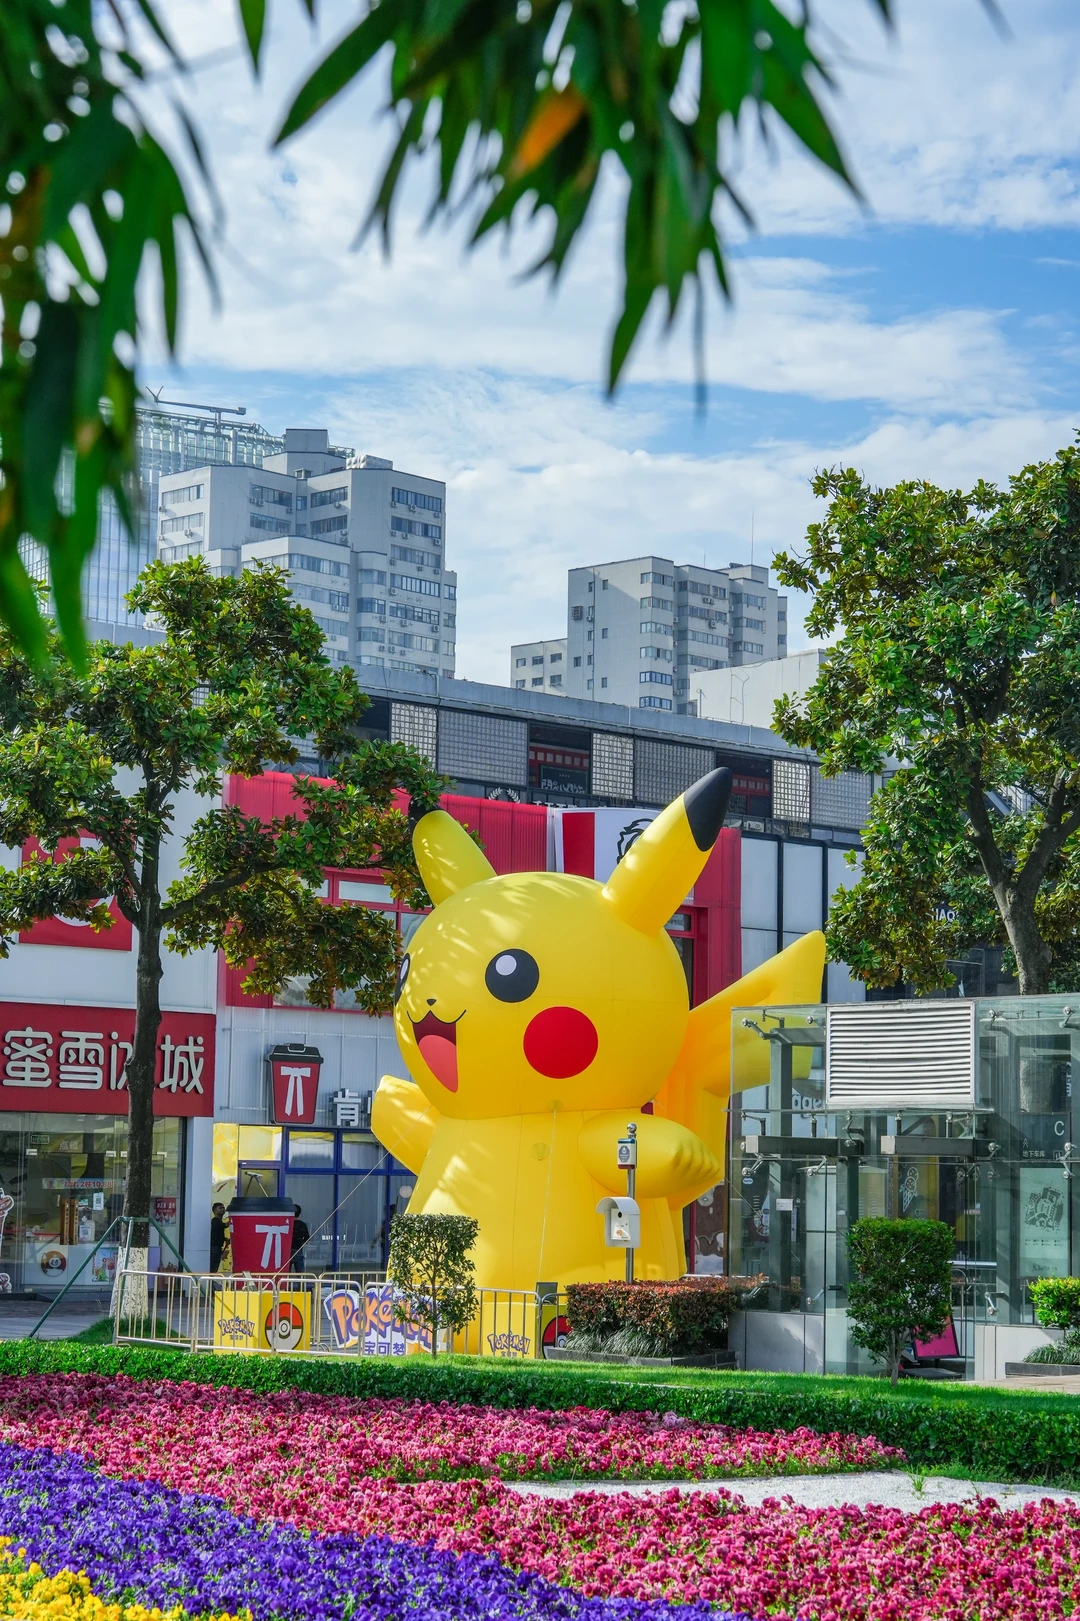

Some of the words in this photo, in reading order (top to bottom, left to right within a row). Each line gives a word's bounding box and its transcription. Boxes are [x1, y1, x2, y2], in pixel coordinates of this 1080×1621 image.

[333, 1088, 374, 1127] 肯
[1054, 1120, 1065, 1136] C
[1022, 1150, 1046, 1158] 地下车库
[363, 1341, 405, 1356] 宝可梦
